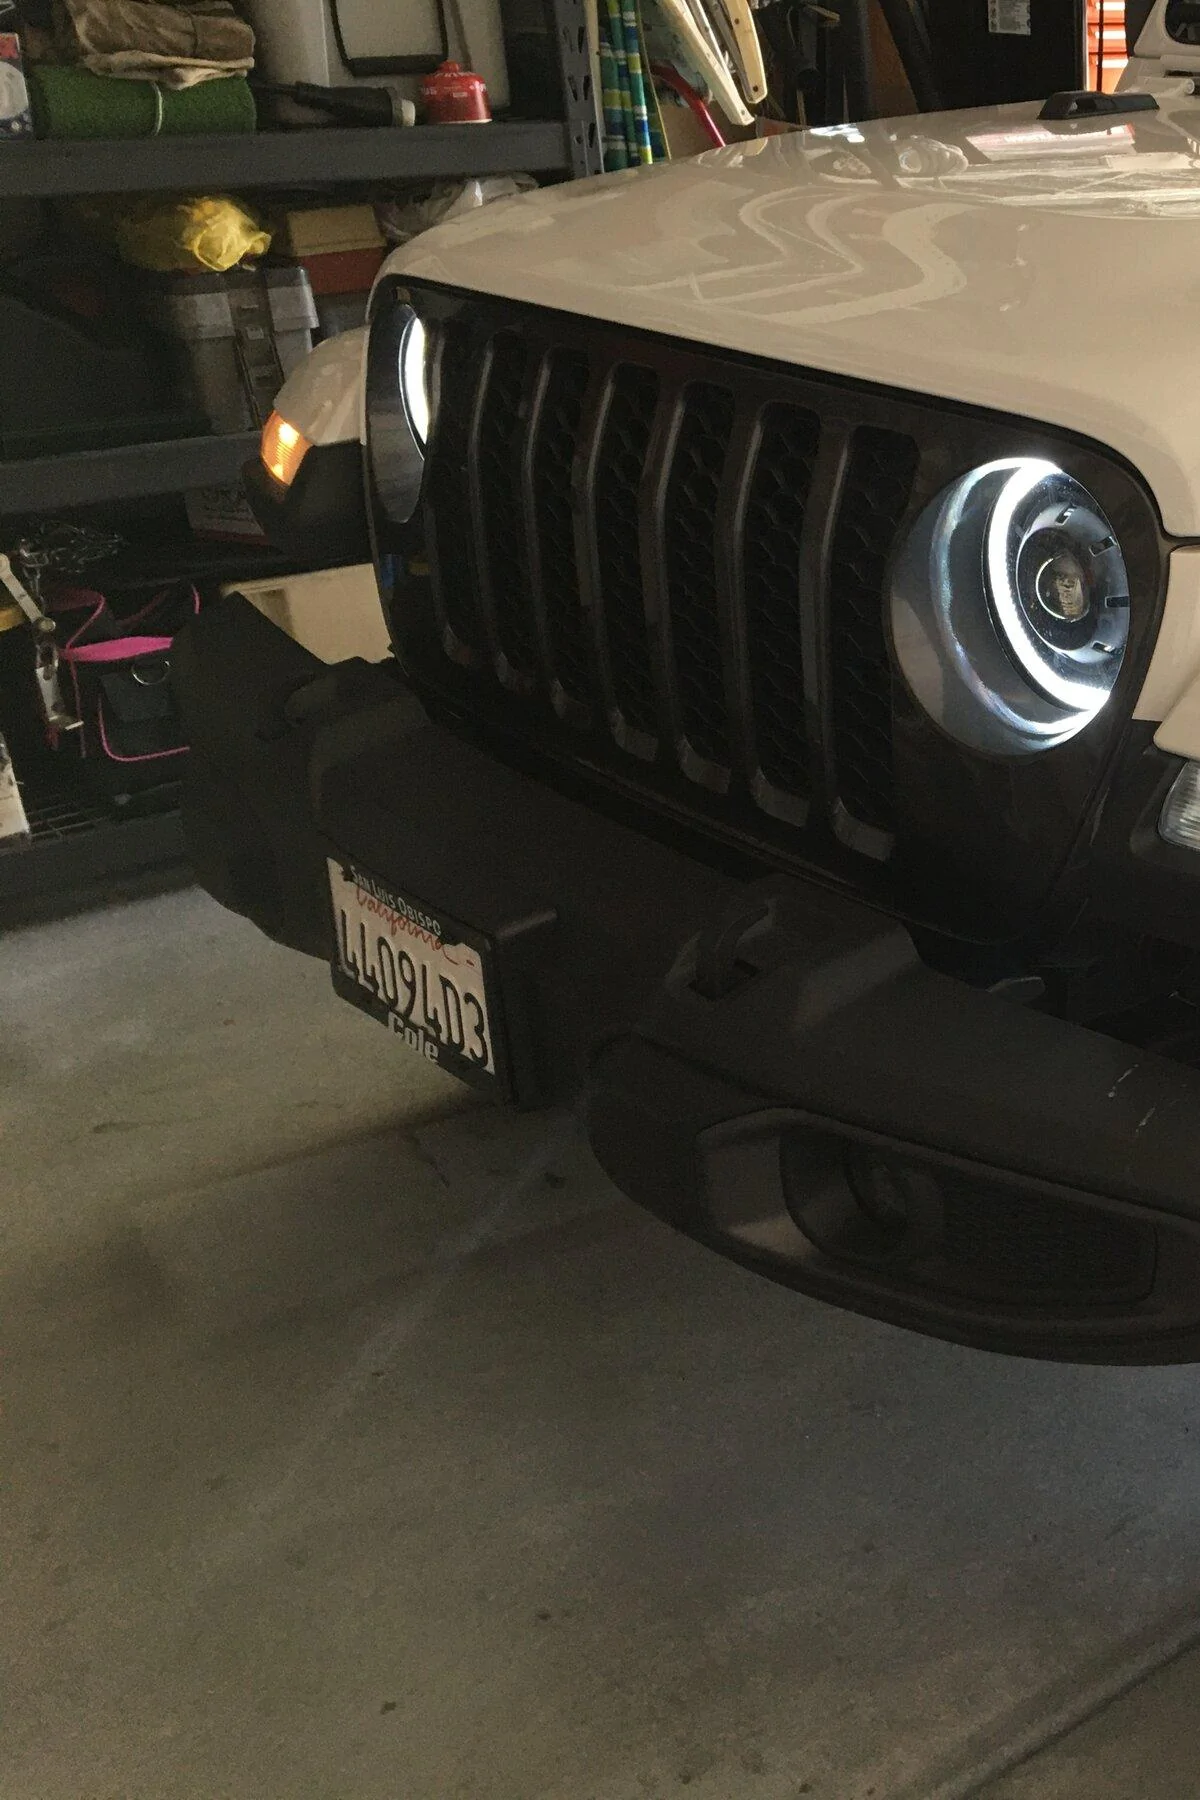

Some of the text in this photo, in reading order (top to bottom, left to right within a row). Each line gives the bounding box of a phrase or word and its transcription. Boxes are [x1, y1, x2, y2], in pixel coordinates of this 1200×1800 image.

[371, 880, 396, 909] LUIS
[398, 897, 441, 936] OBISPO
[341, 908, 488, 1067] 44094D3
[388, 1011, 439, 1063] Cole
